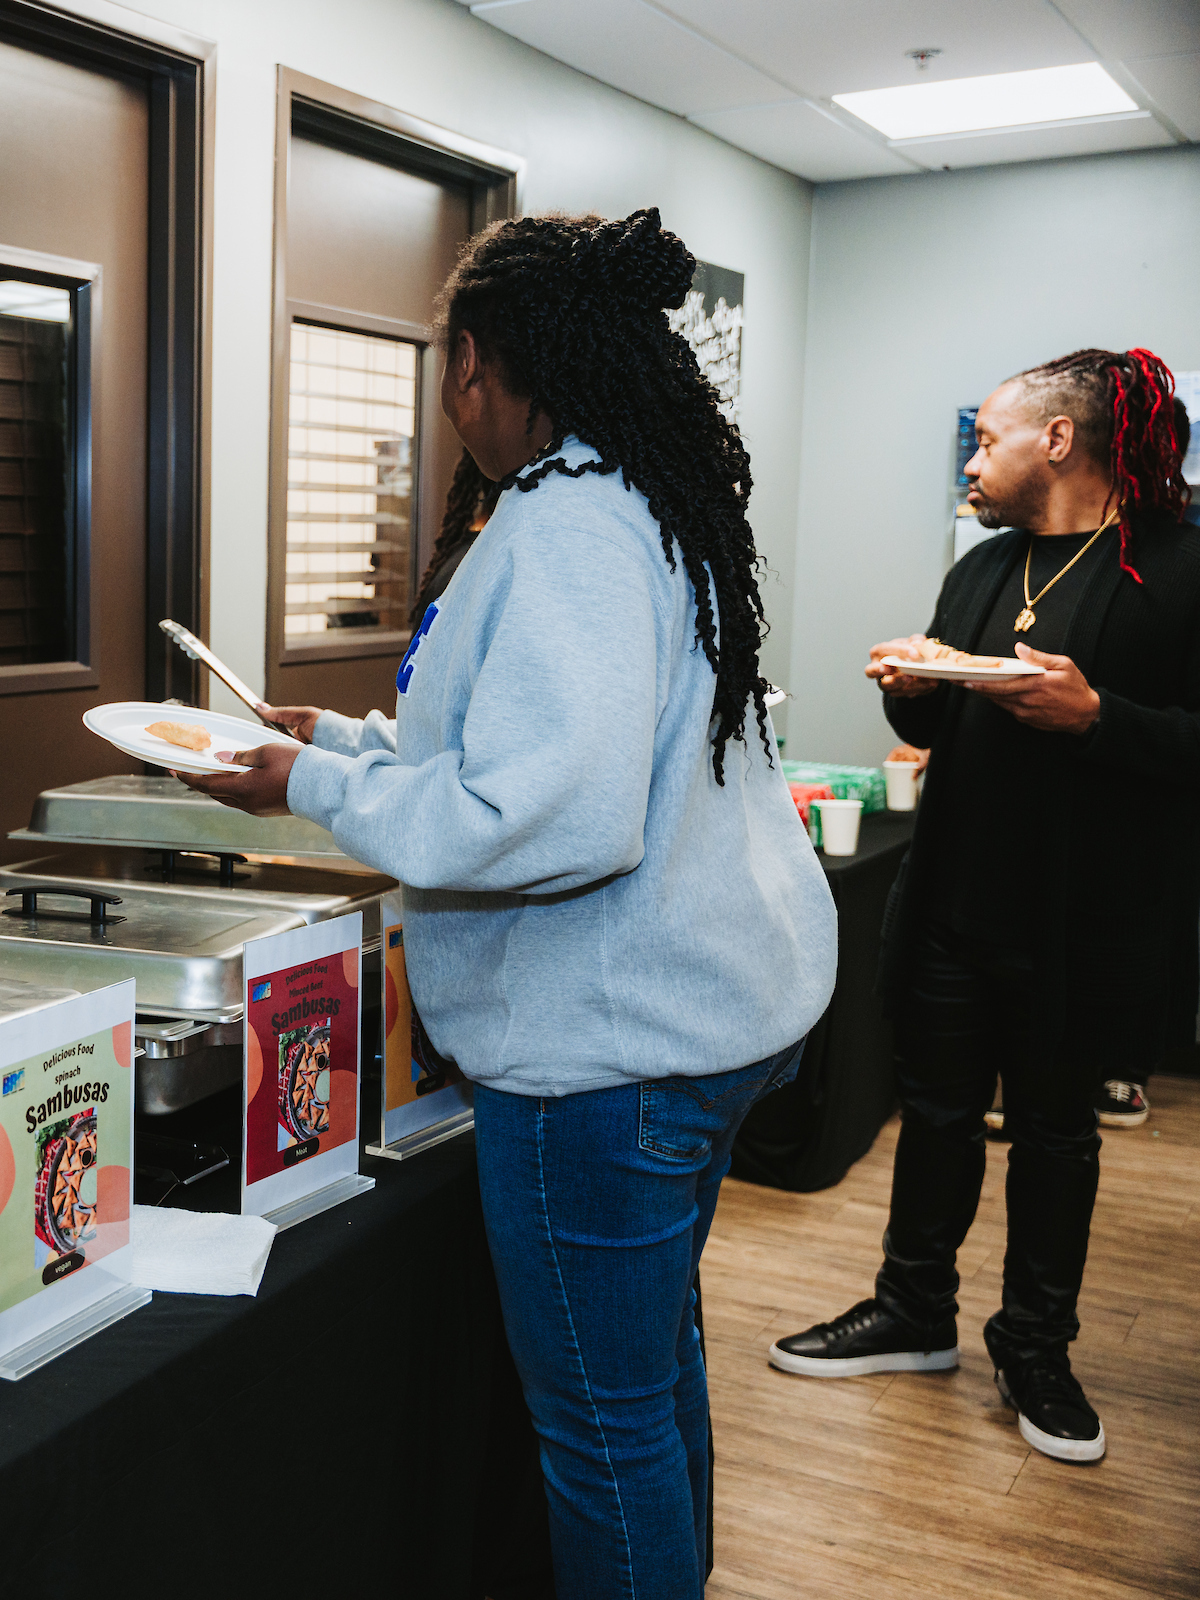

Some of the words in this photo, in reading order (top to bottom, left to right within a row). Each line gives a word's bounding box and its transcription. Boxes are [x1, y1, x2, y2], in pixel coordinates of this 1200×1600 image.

[286, 966, 313, 985] Delicious
[314, 963, 328, 974] Food
[310, 980, 323, 991] Beef
[271, 997, 341, 1036] Sambusas
[43, 1047, 76, 1072] Delicious
[77, 1043, 95, 1055] Food
[54, 1065, 81, 1085] spinach
[25, 1081, 110, 1133] Sambusas
[55, 1260, 72, 1273] vegan
